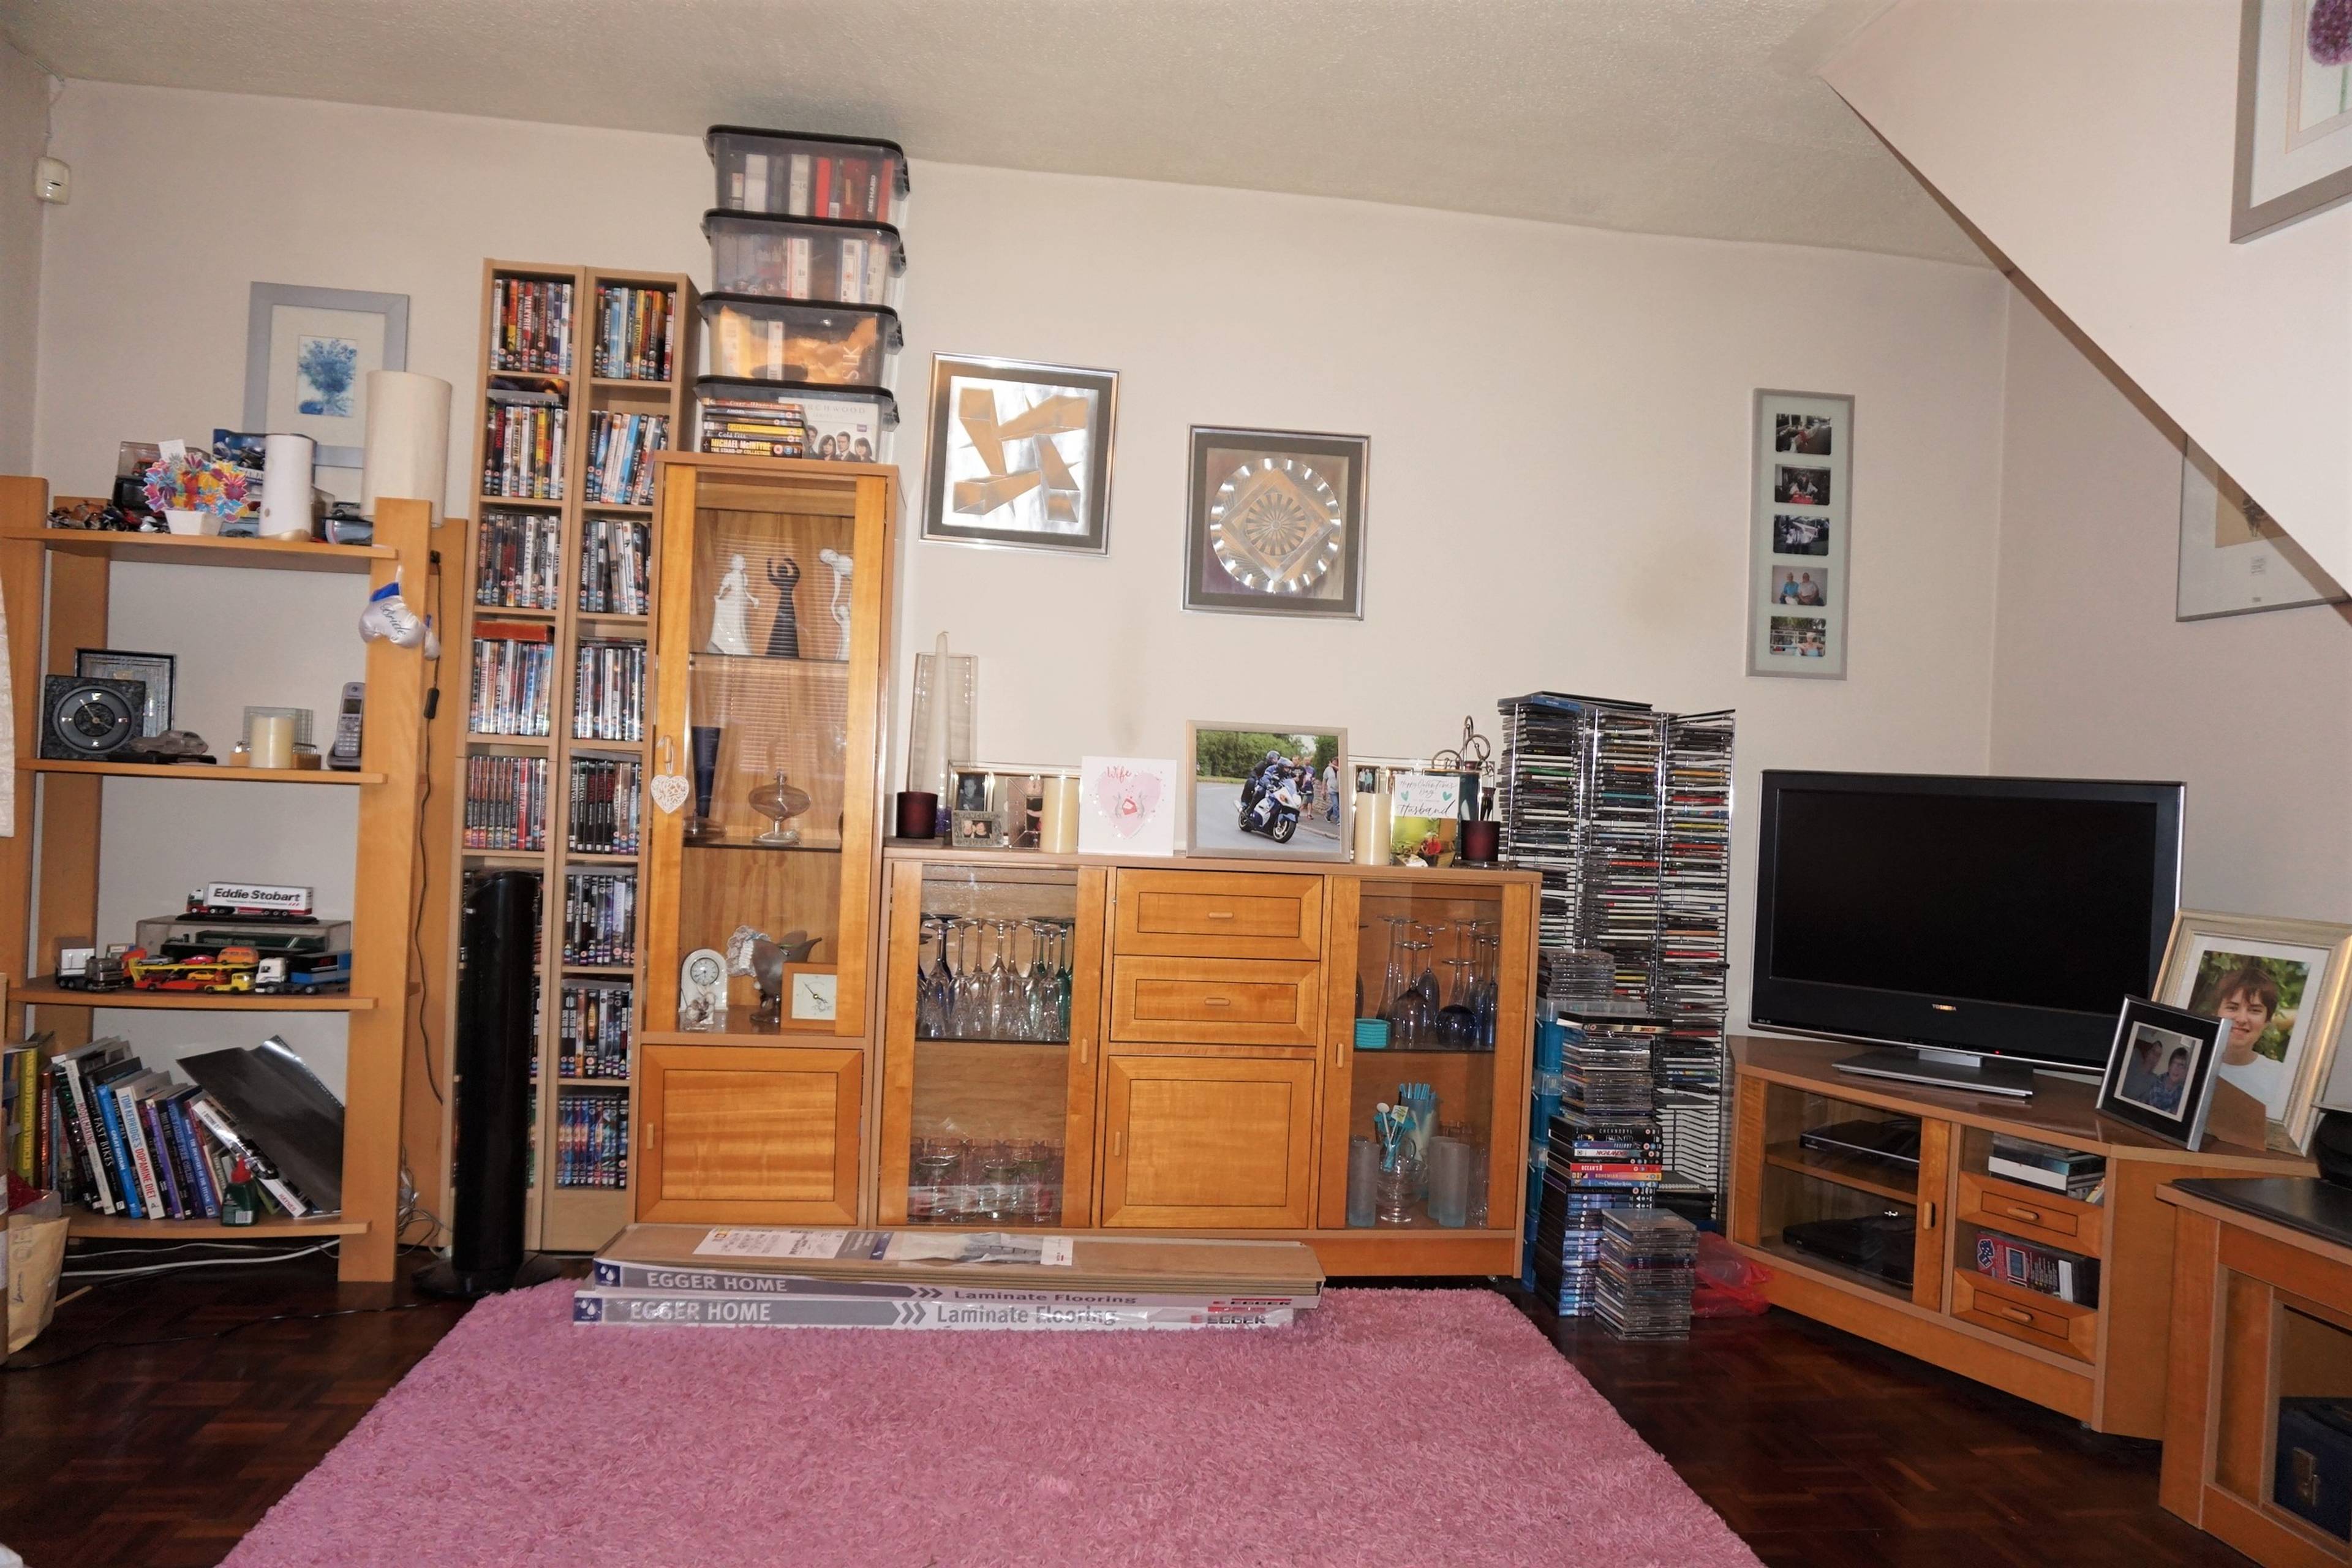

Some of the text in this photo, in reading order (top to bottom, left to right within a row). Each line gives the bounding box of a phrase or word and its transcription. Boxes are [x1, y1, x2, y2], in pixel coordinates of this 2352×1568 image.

[523, 296, 532, 331] VALKYRIE
[496, 410, 504, 448] INCEPTION
[711, 439, 738, 448] MICHAEL
[380, 603, 411, 636] Bride
[1107, 766, 1132, 784] Wife
[1398, 799, 1455, 819] Husband
[214, 888, 301, 902] Eddie Stobart
[25, 1051, 34, 1075] TANKS
[23, 1094, 33, 1131] FIGHTING
[77, 1102, 95, 1145] MODELMAKING
[21, 1131, 32, 1169] VEHICLES
[93, 1117, 105, 1138] FAST
[100, 1140, 114, 1167] BIKES
[110, 1129, 126, 1170] GREAT BRITAIN
[121, 1094, 156, 1199] TOM KERRIDGE'S DOPAMINE DIET
[167, 1103, 193, 1183] YOUR FAMILY TREE ONLINE
[192, 1147, 202, 1170] DISCOVERY
[202, 1186, 210, 1203] TITANIC
[277, 1193, 296, 1212] HAYNES
[647, 1272, 787, 1292] EGGER HOME
[629, 1302, 771, 1322] EGGER HOME
[954, 1291, 1137, 1305] Laminate Flooring
[938, 1305, 1118, 1325] Laminate Flooring
[1208, 1315, 1266, 1324] EGGER
